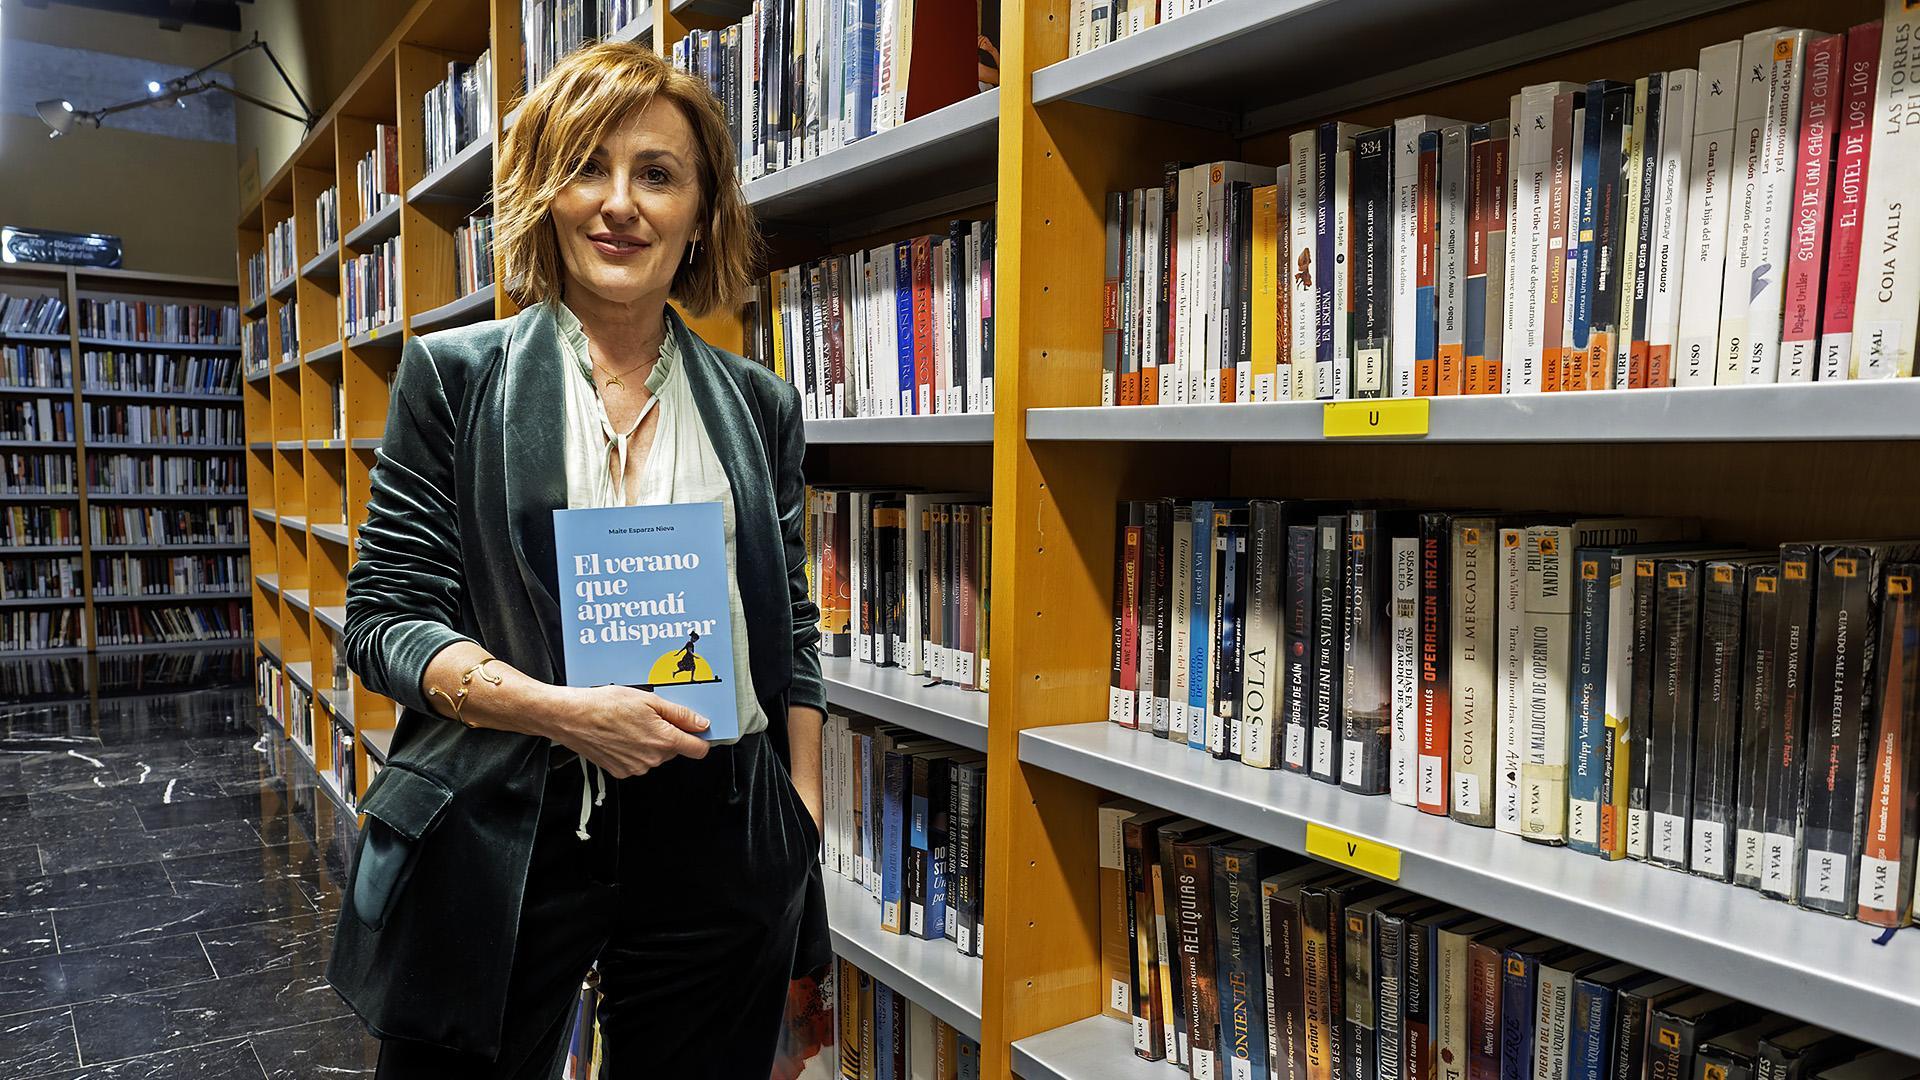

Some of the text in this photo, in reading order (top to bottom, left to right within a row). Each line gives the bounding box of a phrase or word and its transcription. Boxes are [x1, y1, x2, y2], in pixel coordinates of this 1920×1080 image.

[1887, 24, 1910, 134] LAS TORRES
[1361, 139, 1382, 155] 334
[1797, 51, 1830, 261] SUEÑOS DE UNA CHICA DE CIUDAD
[1840, 61, 1870, 227] EL HOTEL DE LOS LÍOS
[1299, 188, 1307, 199] de
[1318, 153, 1326, 235] BARRY UNSWORTH
[1449, 182, 1457, 200] Uribe
[1552, 147, 1564, 230] SUAREN FROGA
[1584, 187, 1592, 215] Mariak
[1700, 142, 1718, 262] Clara Usón La hija del Este
[1740, 128, 1759, 268] Clara Usón Corazón de napalm
[1298, 201, 1307, 224] cielo
[1298, 227, 1307, 235] El
[1367, 200, 1375, 225] LIRIOS
[1448, 202, 1456, 225] Kirmen
[1636, 157, 1654, 300] kabitu ezina Aintzane Usandizaga
[1659, 160, 1676, 293] zomorrotu Aintzane Usandizaga
[1761, 183, 1774, 262] ALFONSO USSÍA
[1367, 243, 1374, 252] DE
[1448, 229, 1456, 254] bilbao
[1527, 171, 1543, 326] Kirmen Uribe La hora de despertarnos
[1878, 202, 1902, 303] COIA VALLS
[1448, 262, 1458, 280] york
[1551, 256, 1560, 283] Urkizu
[1580, 249, 1589, 293] Urretabizkaia
[1367, 286, 1374, 296] LA
[1578, 294, 1586, 321] Arantxa
[1322, 291, 1331, 341] EN ESCENA
[1446, 306, 1455, 331] bilbao
[1622, 299, 1631, 331] Lecciones
[1691, 344, 1700, 365] USO
[1730, 337, 1740, 361] USO
[1752, 343, 1763, 364] USS
[1792, 344, 1804, 366] UVI
[1828, 345, 1838, 378] N UVI
[1369, 411, 1379, 426] U
[629, 526, 654, 534] Esparza
[574, 552, 699, 576] El verano
[576, 579, 628, 603] que
[577, 591, 685, 625] aprendí
[1353, 564, 1362, 624] EL ROCE
[1464, 549, 1477, 661] EL MERCADER
[579, 619, 716, 645] a disparar
[1318, 587, 1333, 729] CARICIAS DEL INFIERNO
[1405, 627, 1414, 709] NUEVE DÍAS EN
[1787, 625, 1799, 688] FRED VARGAS
[1831, 610, 1848, 738] CUANDO SALE LA RECLUSA
[1246, 647, 1267, 726] SOLA
[1290, 663, 1302, 697] DE CAÍN
[1530, 626, 1548, 764] LA MALDICIÓN DE COPÉRNICO
[1424, 689, 1433, 750] VICENTE VALLÉS
[1463, 686, 1474, 765] COIA VALLS
[1578, 683, 1592, 776] Philipp Vandenberg
[960, 840, 968, 868] FIESTA
[1347, 842, 1357, 857] V
[1873, 865, 1887, 903] N VAR
[1179, 875, 1202, 954] RELIQUIAS
[1282, 920, 1290, 976] La Expatriada
[1189, 956, 1200, 1027] VAUGHAN-HUGHES
[1306, 940, 1318, 1066] el señor de las tinieblas
[1539, 982, 1551, 1079] PUERTA DEL PACÍFICO
